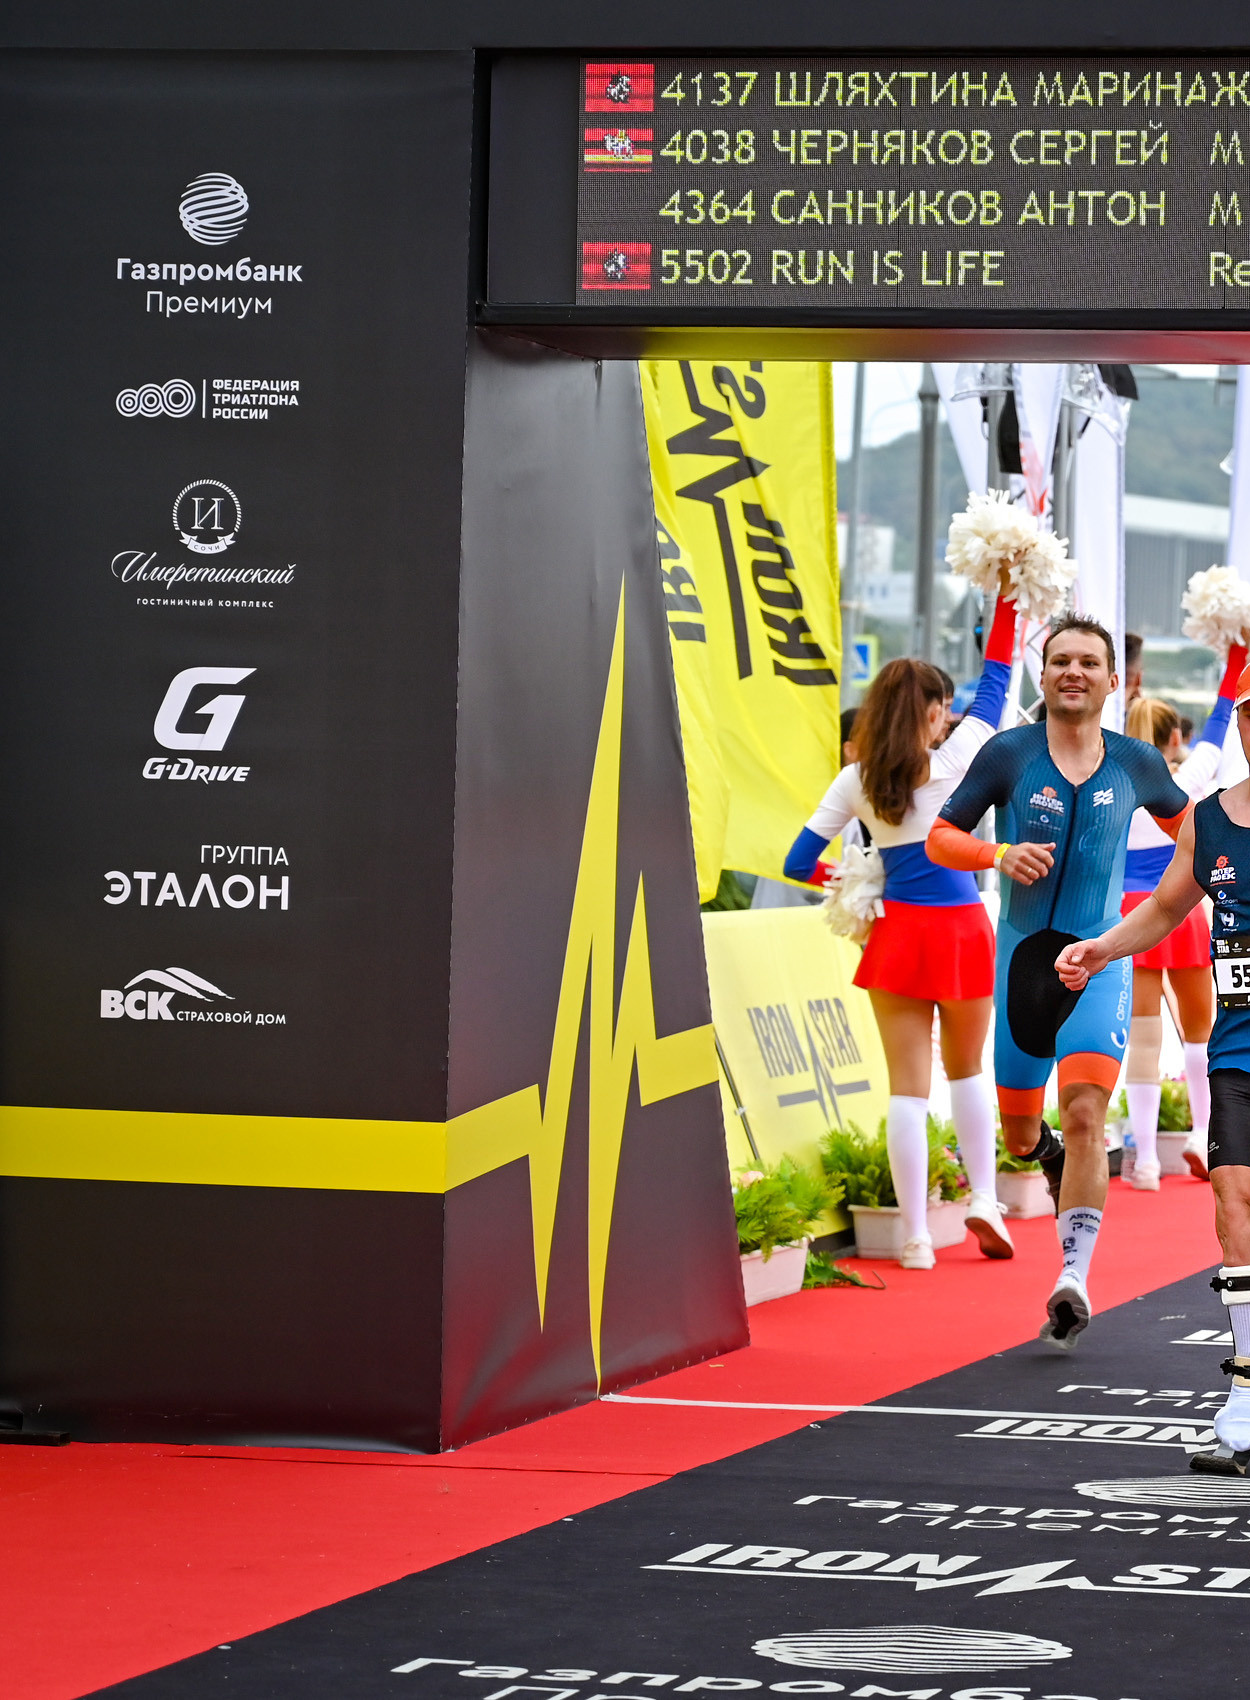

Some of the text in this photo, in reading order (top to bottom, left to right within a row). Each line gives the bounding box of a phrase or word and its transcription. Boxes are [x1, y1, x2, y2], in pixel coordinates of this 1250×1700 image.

[661, 71, 757, 107] 4137
[774, 71, 1017, 107] ШЛЯХТИНА
[660, 130, 756, 164] 4038
[772, 130, 993, 164] ЧЕРНЯКОВ
[1010, 120, 1168, 165] СЕРГЕЙ
[1209, 131, 1244, 165] М
[659, 190, 756, 225] 4364
[771, 190, 1002, 225] САННИКОВ
[1017, 190, 1165, 225] АНТОН
[1209, 191, 1242, 226] М
[116, 257, 303, 285] Газпромбанк
[660, 250, 753, 285] 5502
[771, 250, 854, 285] RUN
[872, 250, 903, 285] IS
[921, 250, 1004, 286] LIFE
[146, 290, 273, 320] Премиум
[212, 379, 299, 392] ФЕДЕРАЦИЯ
[212, 393, 299, 406] ТРИАТЛОНА
[212, 407, 269, 420] РОССИИ
[193, 542, 222, 553] СОЧИ
[110, 550, 297, 591] Имеретинский
[136, 597, 275, 608] ГОСТИНИЧНЫЙ КОМПЛЕКС
[200, 844, 289, 867] ГРУППА
[103, 870, 289, 911] ЭТАЛОН
[101, 989, 286, 1026] ВСК СТРАХОВОЙ ДОМ
[669, 1544, 982, 1575] IRON
